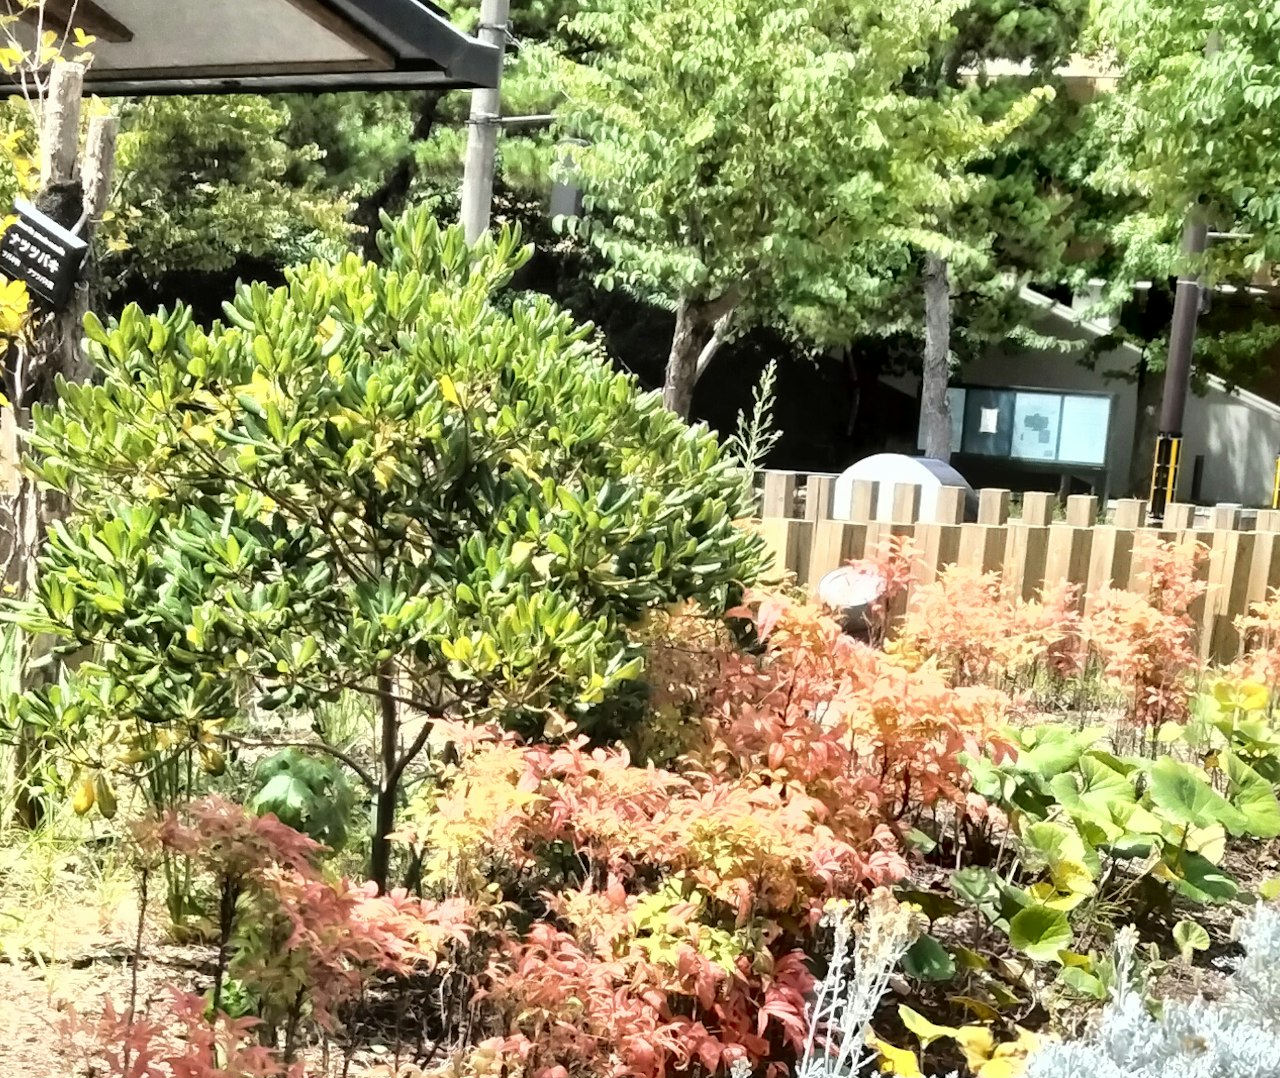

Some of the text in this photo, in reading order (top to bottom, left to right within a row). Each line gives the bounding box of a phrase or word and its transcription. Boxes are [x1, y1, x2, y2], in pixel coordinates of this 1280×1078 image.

[8, 232, 60, 274] ナツツバキ
